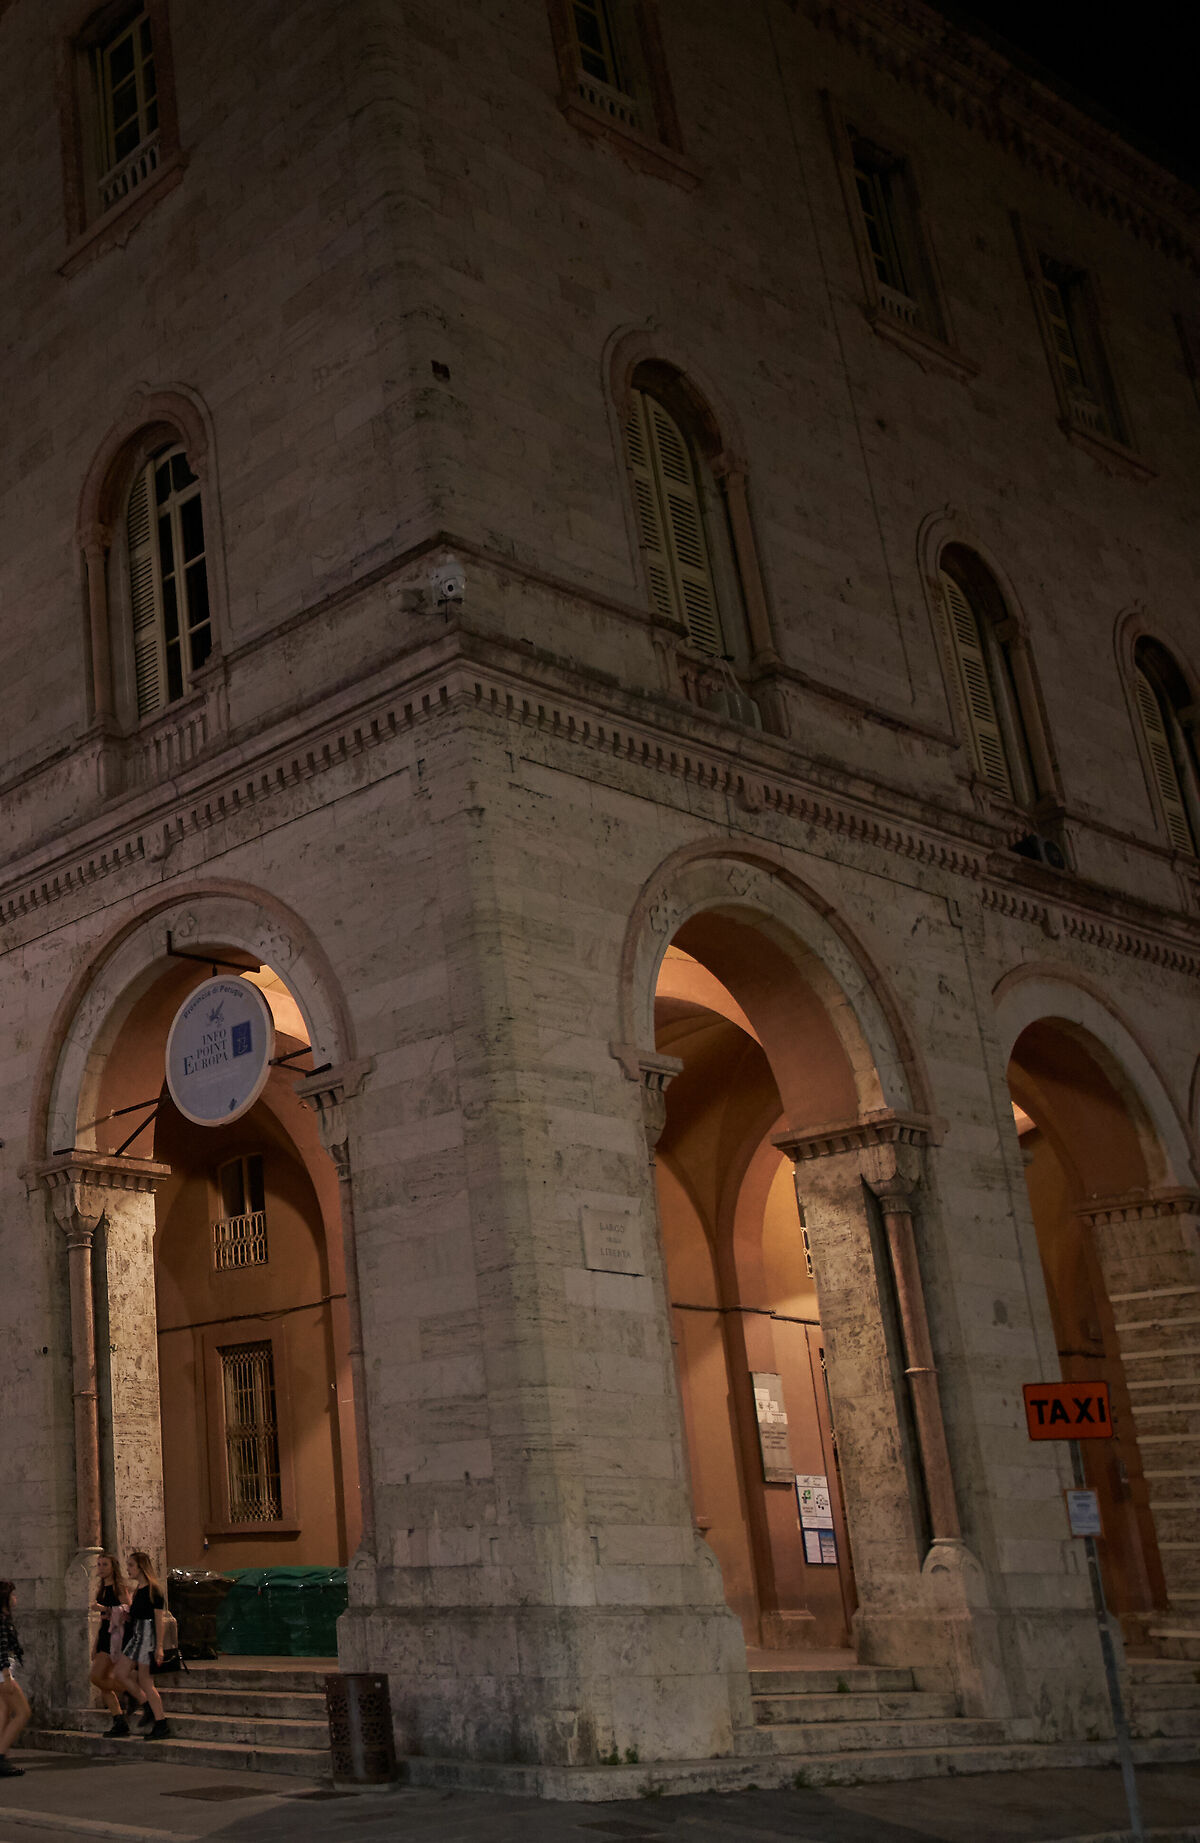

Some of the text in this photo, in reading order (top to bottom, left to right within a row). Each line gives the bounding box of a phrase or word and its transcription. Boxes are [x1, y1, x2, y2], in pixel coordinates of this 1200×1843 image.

[183, 991, 210, 1018] Provincia
[219, 985, 243, 998] Perugia
[202, 1028, 226, 1045] INFO
[197, 1040, 227, 1059] POINT
[183, 1051, 228, 1075] EUROPA
[1029, 1397, 1107, 1425] TAXI
